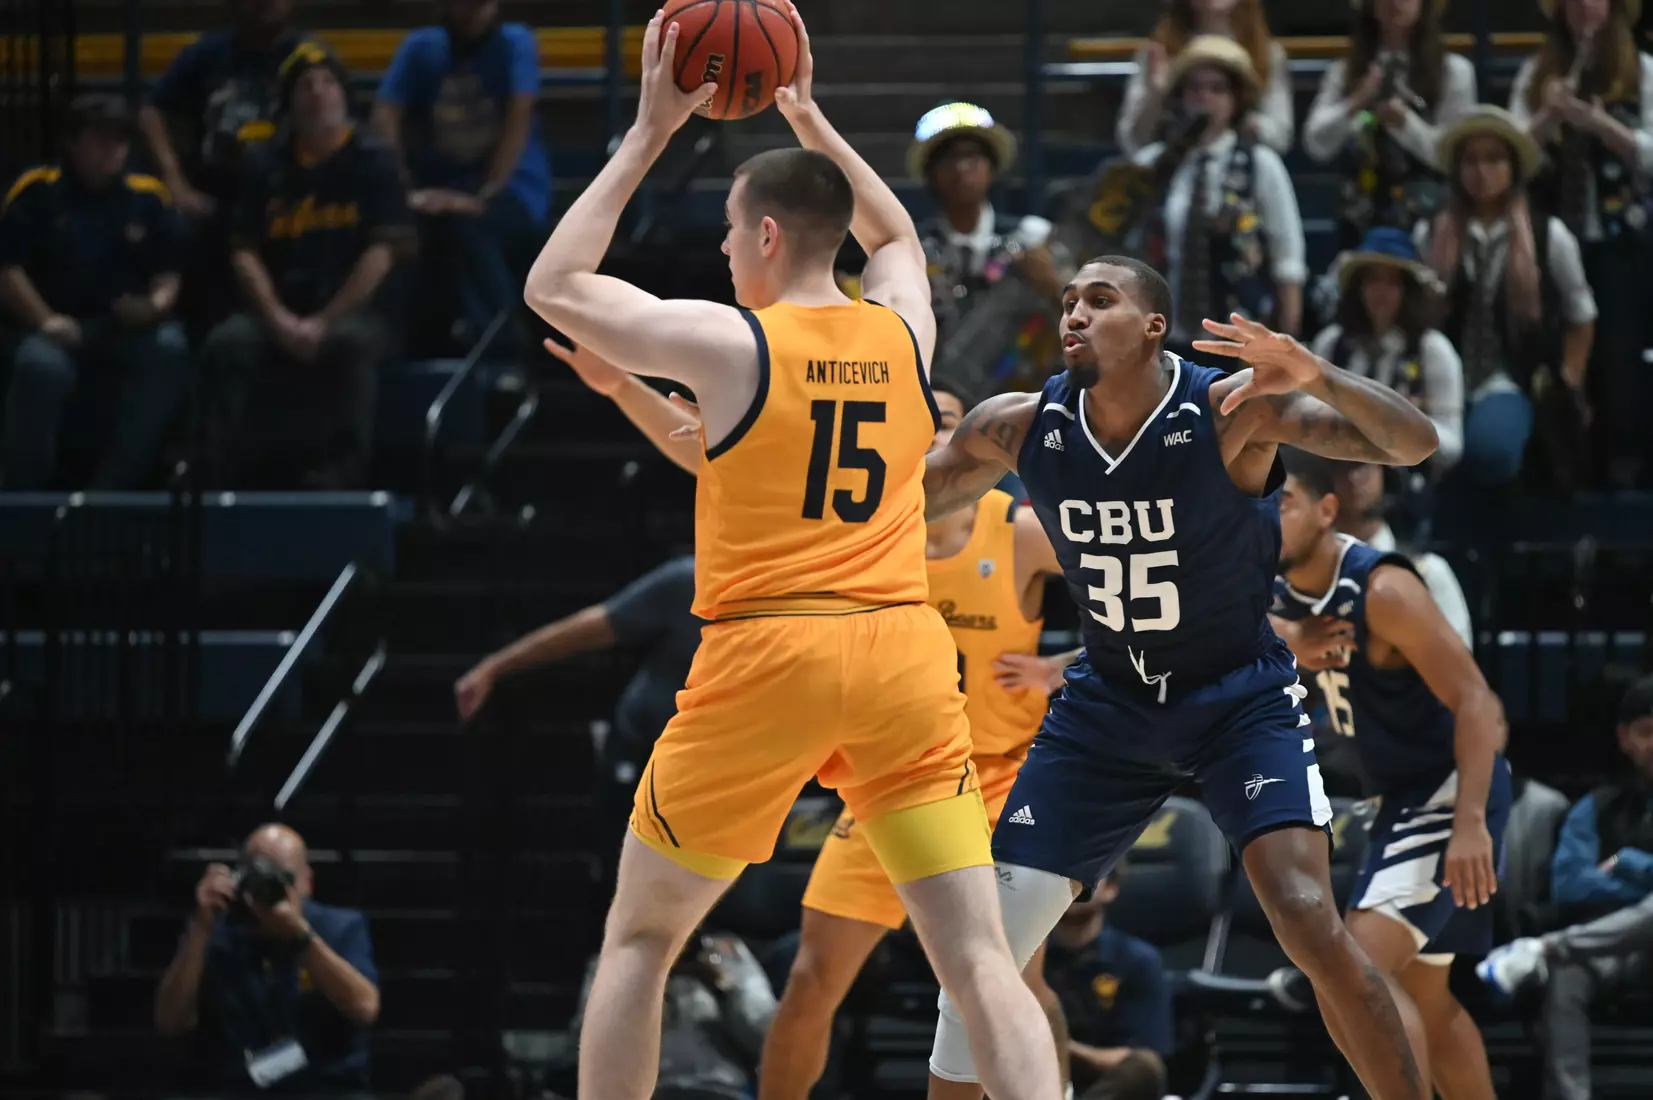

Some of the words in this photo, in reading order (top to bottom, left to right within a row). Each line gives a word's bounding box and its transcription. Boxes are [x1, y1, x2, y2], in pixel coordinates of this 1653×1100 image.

[806, 360, 889, 384] ANTICEVICH
[802, 400, 886, 523] 15
[1163, 429, 1193, 447] WAC
[1058, 498, 1176, 545] CBU
[1080, 549, 1181, 633] 35
